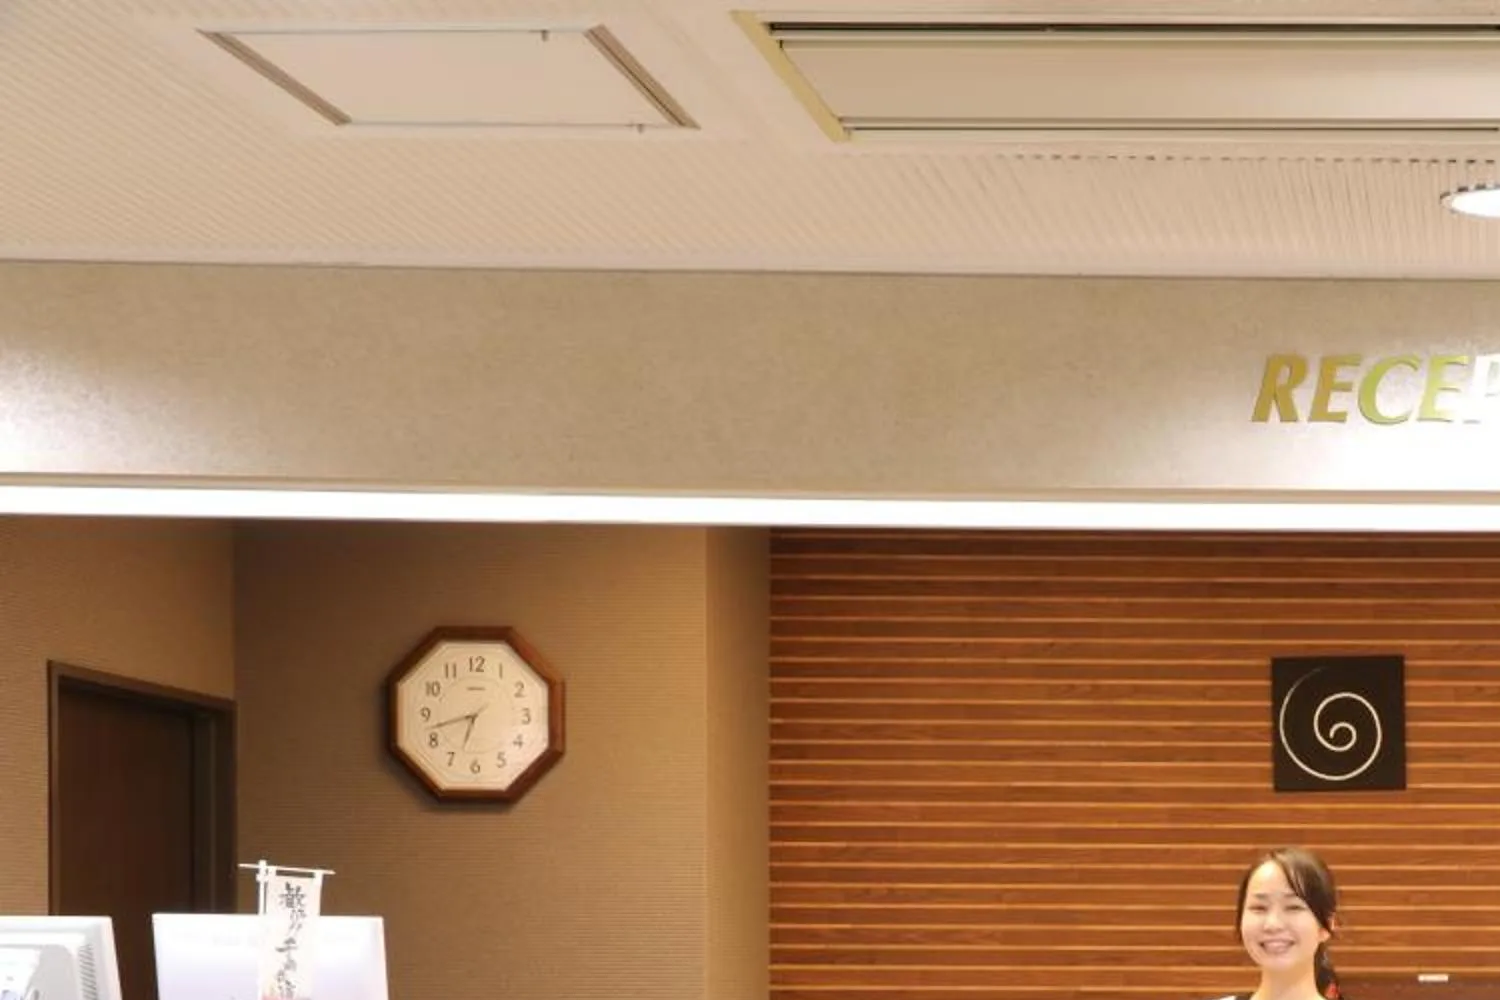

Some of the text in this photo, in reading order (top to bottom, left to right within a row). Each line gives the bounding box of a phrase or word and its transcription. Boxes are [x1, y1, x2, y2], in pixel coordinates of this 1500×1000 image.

[444, 662, 457, 679] 11
[468, 655, 486, 673] 12
[498, 662, 504, 679] 1
[425, 681, 441, 698] 10
[514, 681, 525, 698] 2
[420, 706, 431, 721] 9
[522, 708, 531, 725] 3
[428, 732, 439, 748] 8
[513, 734, 523, 748] 4
[447, 751, 456, 767] 7
[469, 759, 481, 774] 6
[496, 752, 506, 768] 5
